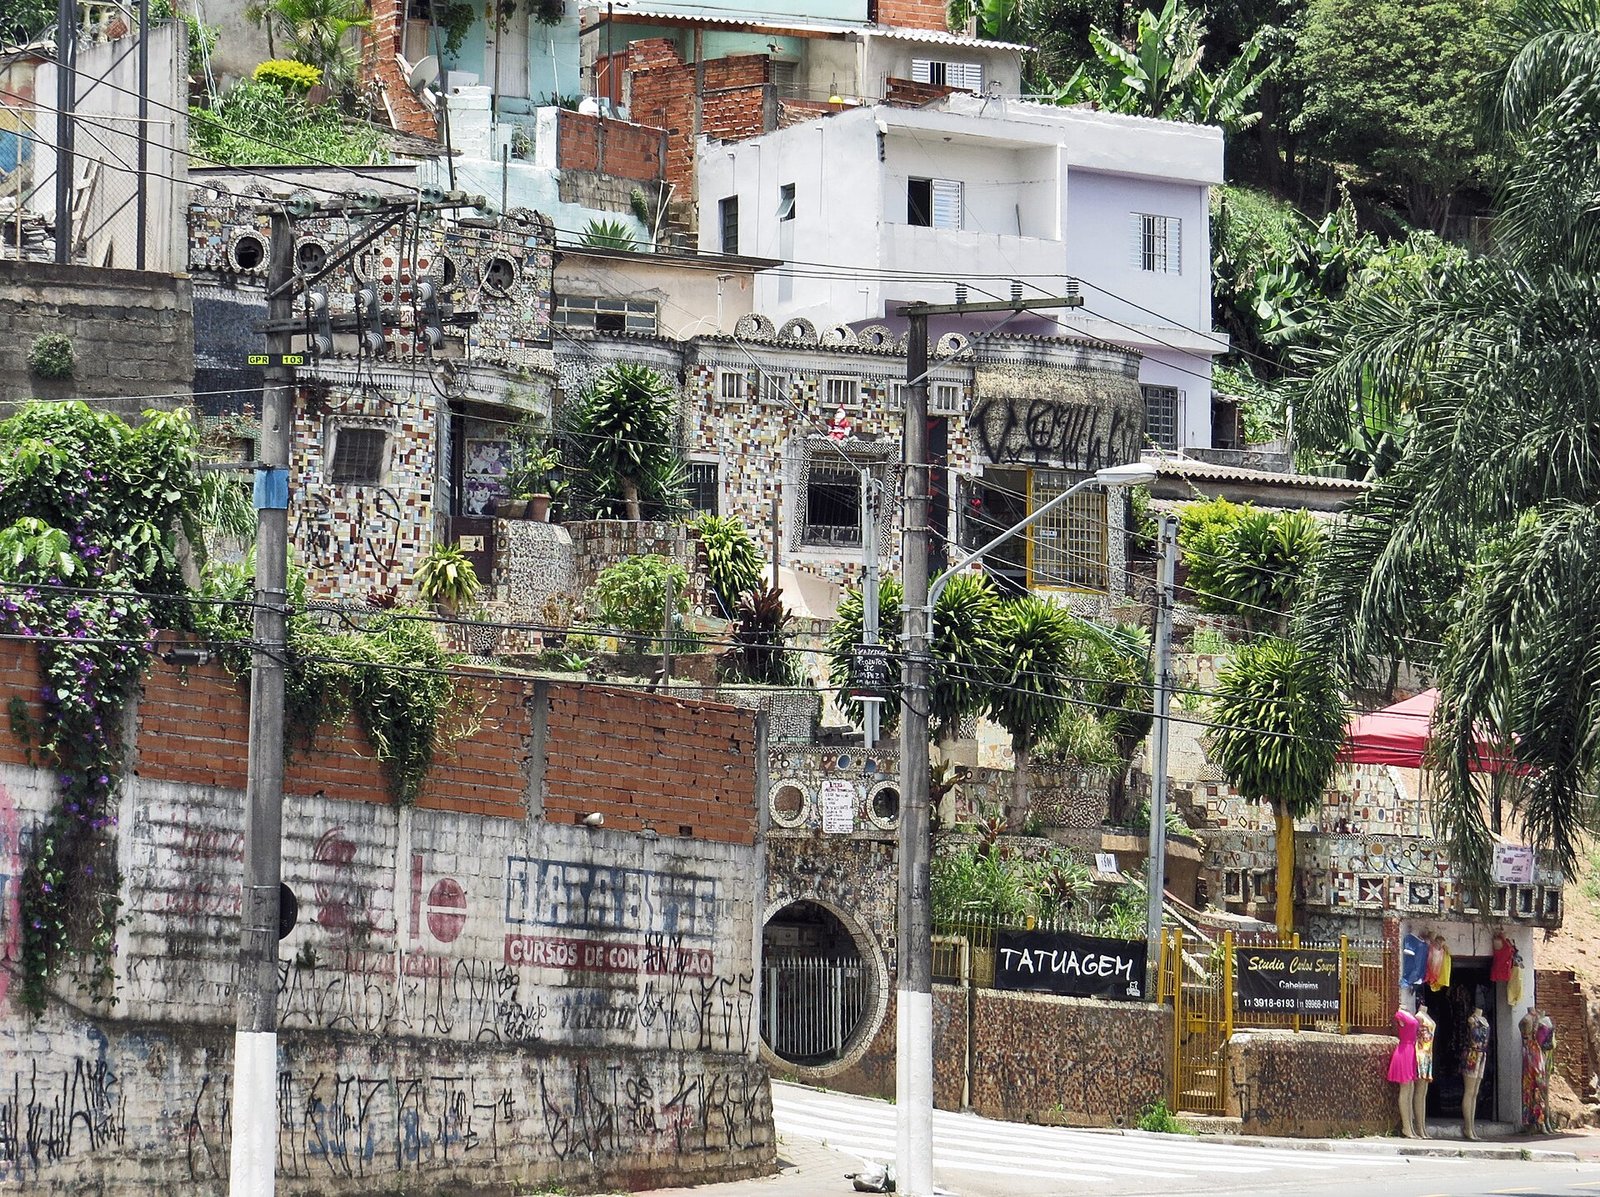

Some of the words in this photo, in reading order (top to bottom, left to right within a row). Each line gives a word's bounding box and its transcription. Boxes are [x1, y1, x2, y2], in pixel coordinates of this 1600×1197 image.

[249, 356, 268, 364] GPR
[284, 356, 303, 364] 103
[510, 939, 578, 966] CURSOS
[584, 945, 603, 967] DE
[1000, 948, 1133, 981] TATUAGEM
[1248, 956, 1285, 971] Studio
[1253, 998, 1295, 1008] 3918-6193
